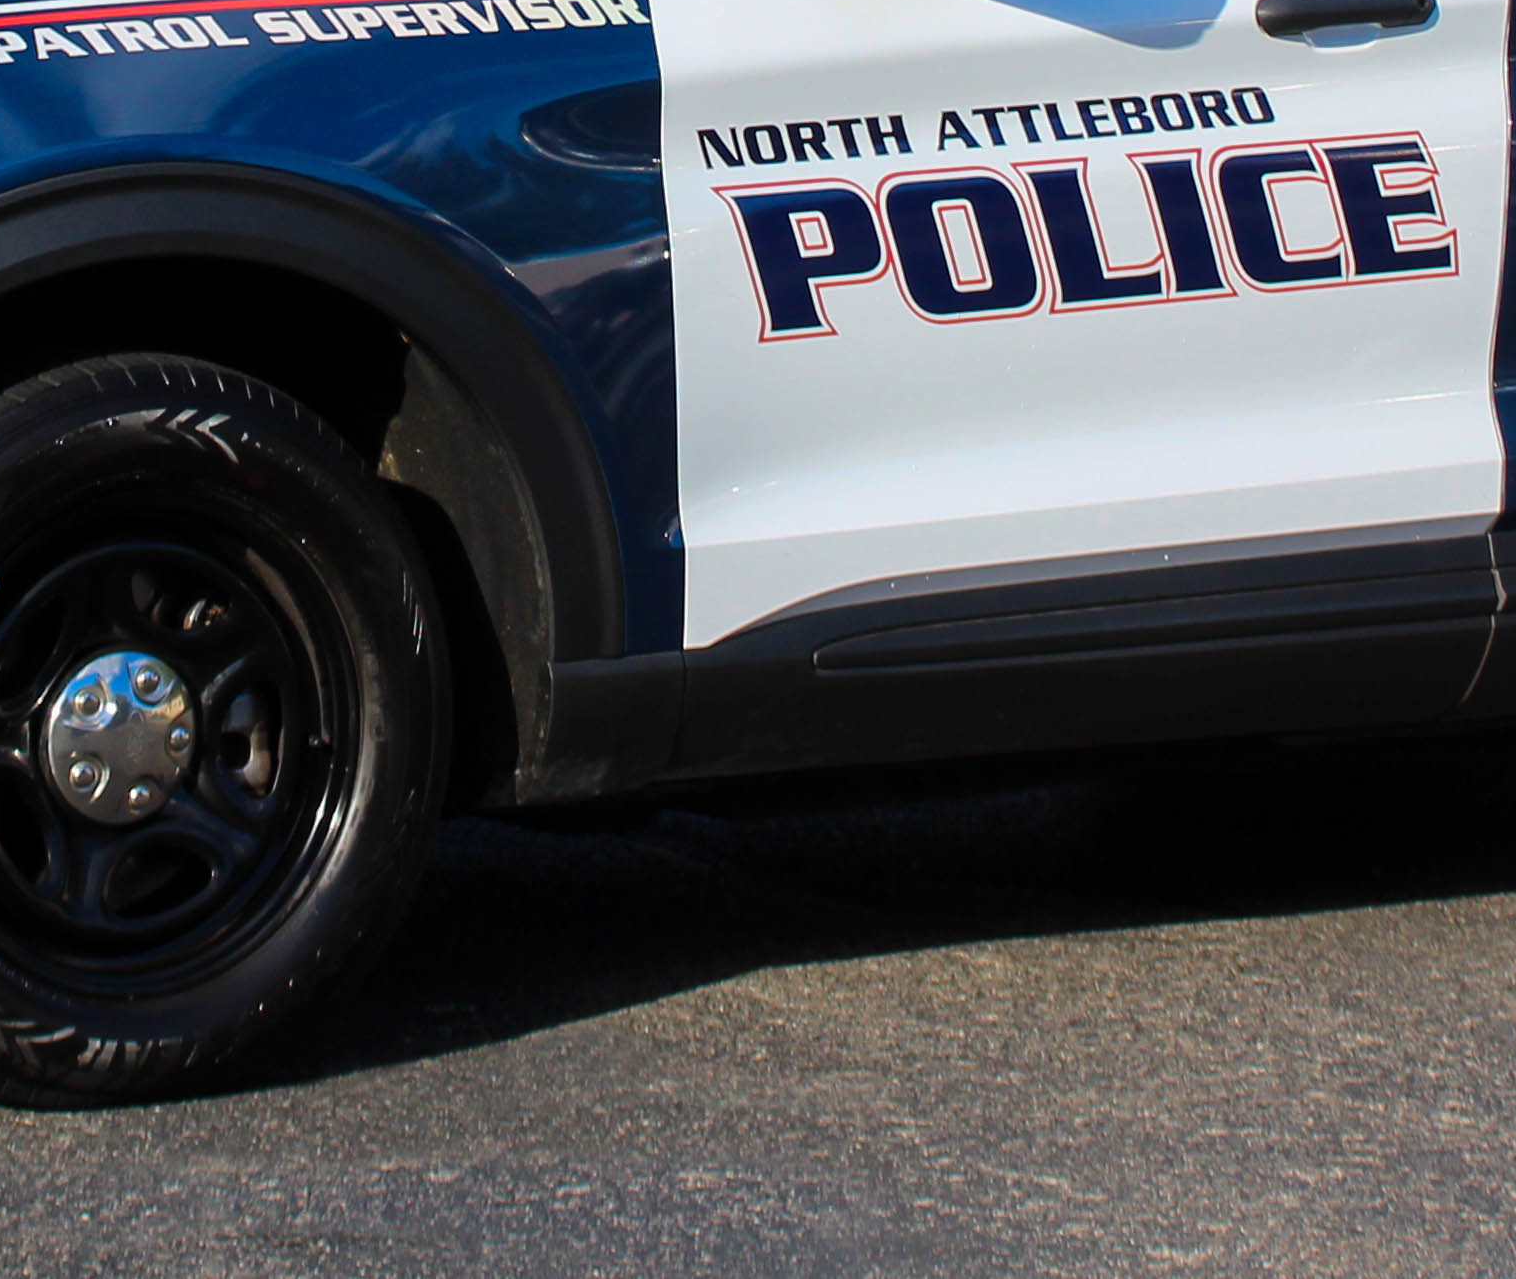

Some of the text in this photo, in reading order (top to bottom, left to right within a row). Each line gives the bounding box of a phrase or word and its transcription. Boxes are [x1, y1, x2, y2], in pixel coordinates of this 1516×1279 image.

[696, 86, 1276, 170] NORTH ATTLEBORO
[712, 131, 1460, 344] POLICE
